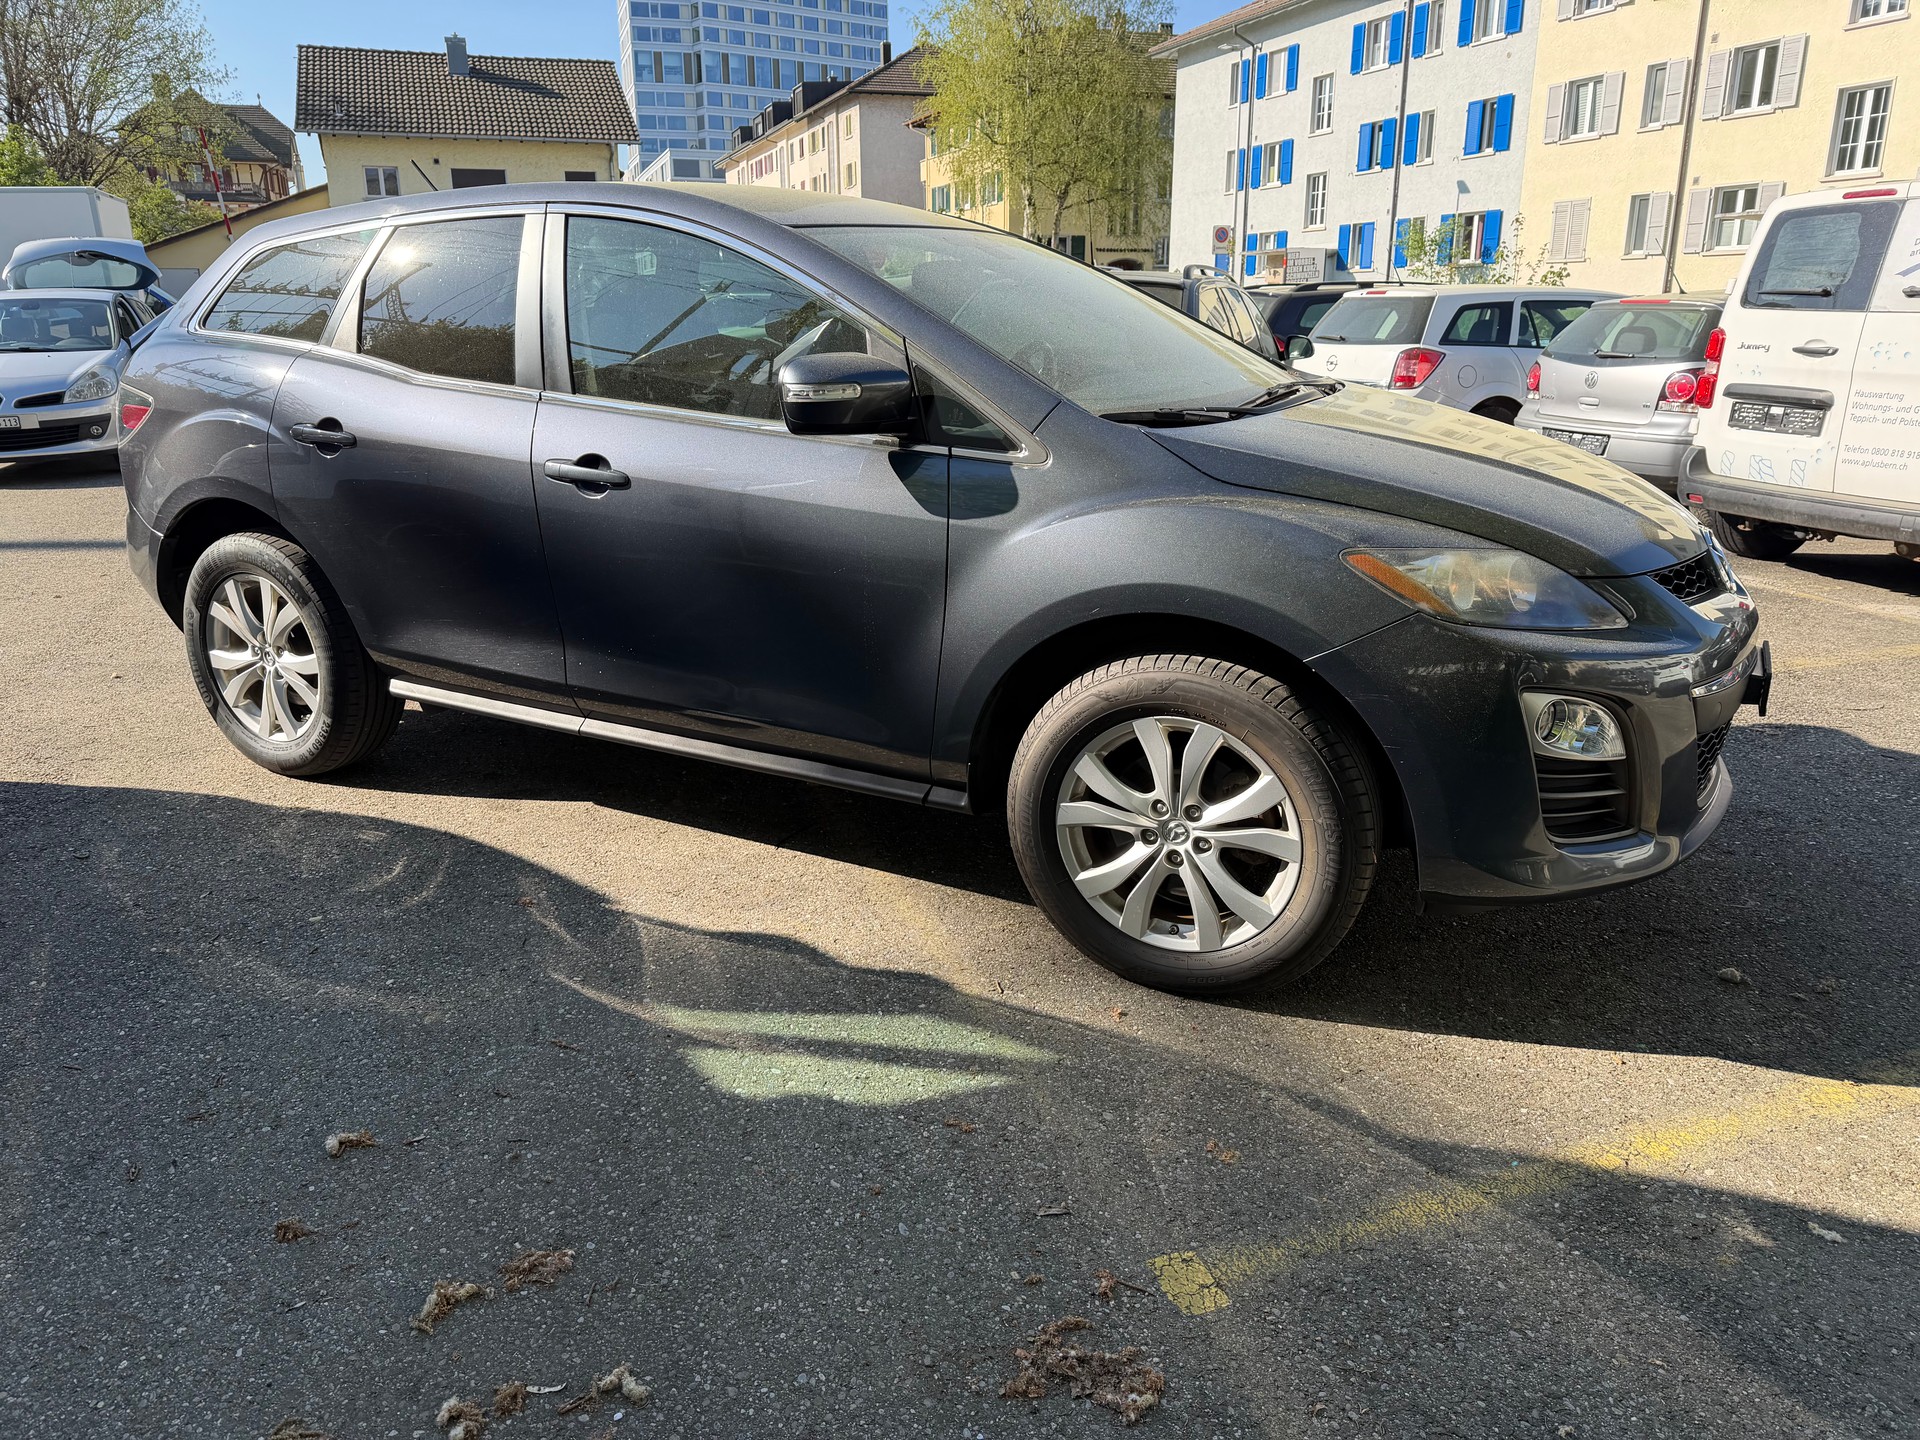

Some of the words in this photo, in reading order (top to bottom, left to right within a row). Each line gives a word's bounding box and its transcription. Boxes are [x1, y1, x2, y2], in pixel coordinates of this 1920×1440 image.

[1854, 389, 1905, 402] Hauswartung
[1852, 401, 1894, 413] Wohnungs-
[1896, 405, 1913, 413] und
[0, 418, 18, 427] 113
[1850, 413, 1880, 423] Teppich-
[1882, 416, 1898, 425] und
[1844, 444, 1870, 454] Telefon
[1871, 447, 1890, 456] 0800
[1891, 449, 1906, 458] 818
[1906, 450, 1920, 459] 918
[1841, 458, 1908, 471] www.aplusbern.ch
